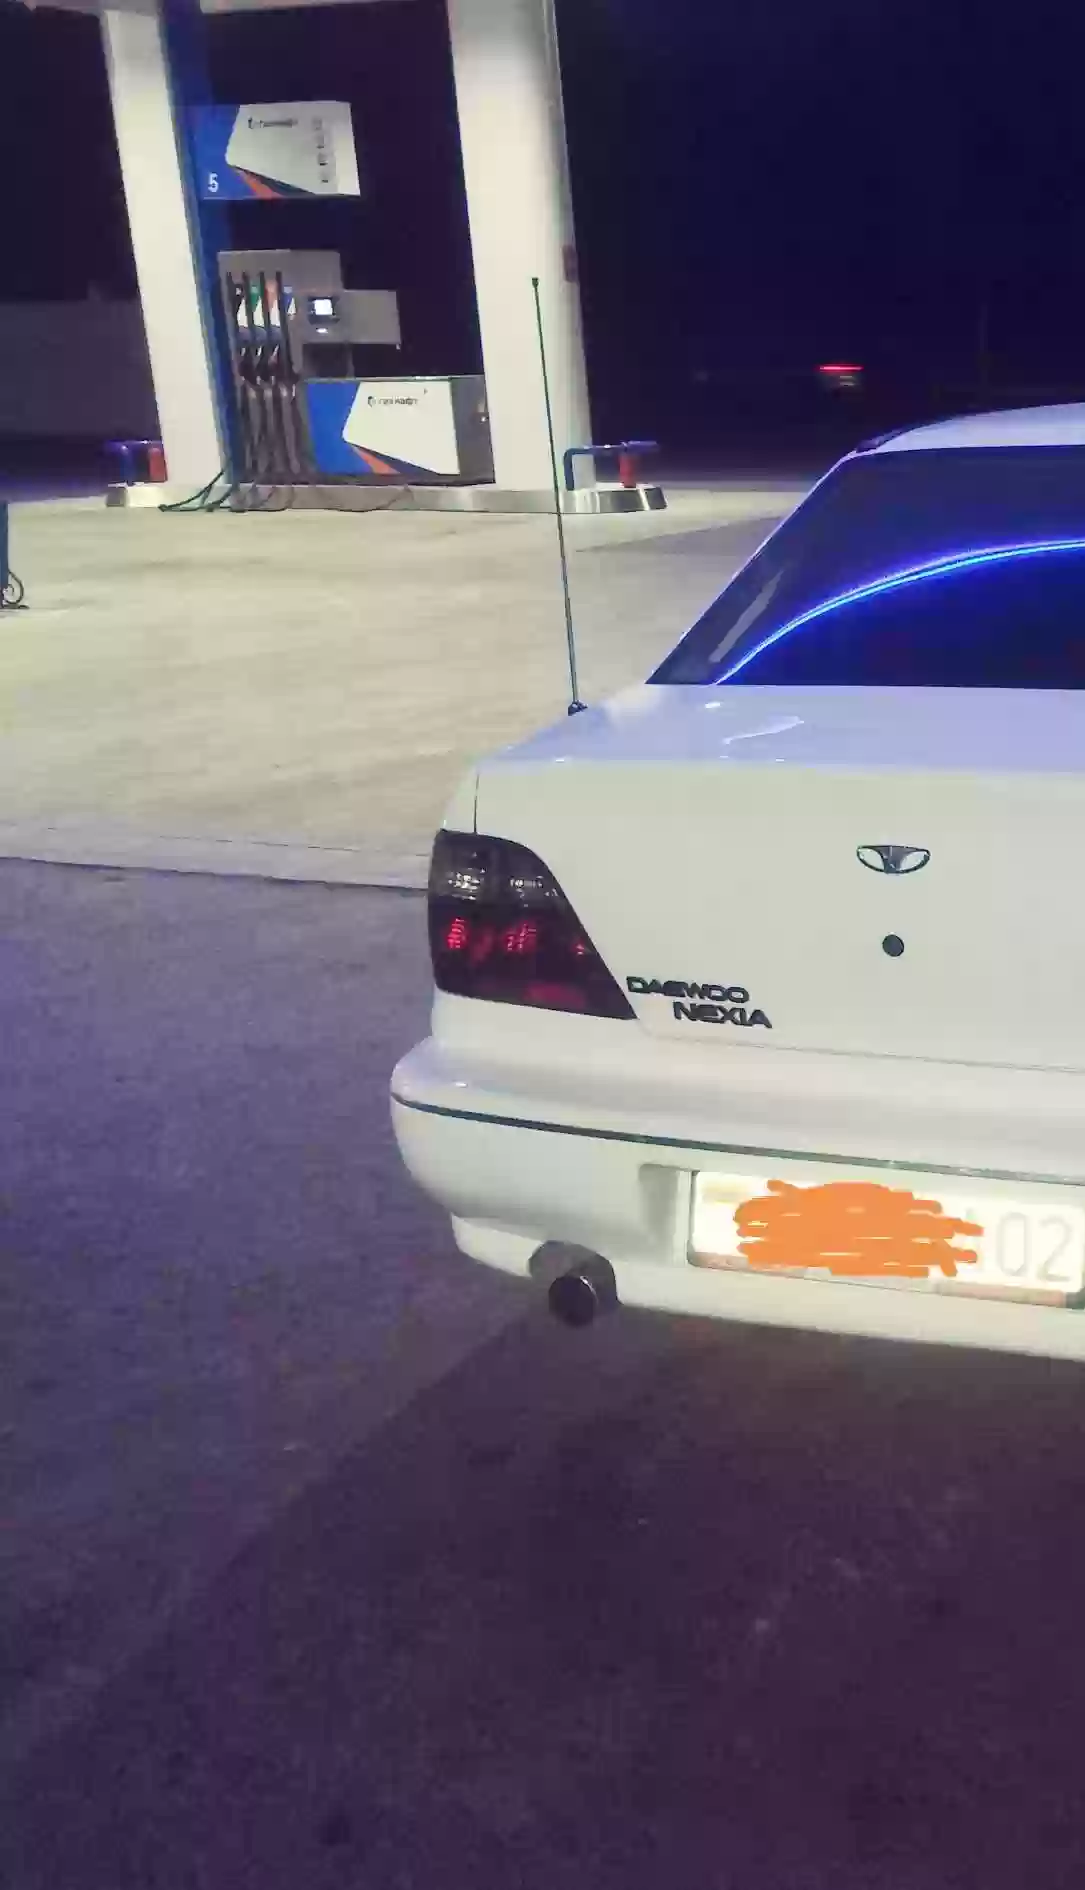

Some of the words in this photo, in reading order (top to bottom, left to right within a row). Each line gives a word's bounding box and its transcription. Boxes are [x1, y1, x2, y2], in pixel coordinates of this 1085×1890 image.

[207, 172, 219, 193] 5
[626, 976, 750, 1003] DAEWOO
[673, 1000, 773, 1029] NEXIA
[994, 1209, 1076, 1283] 02
